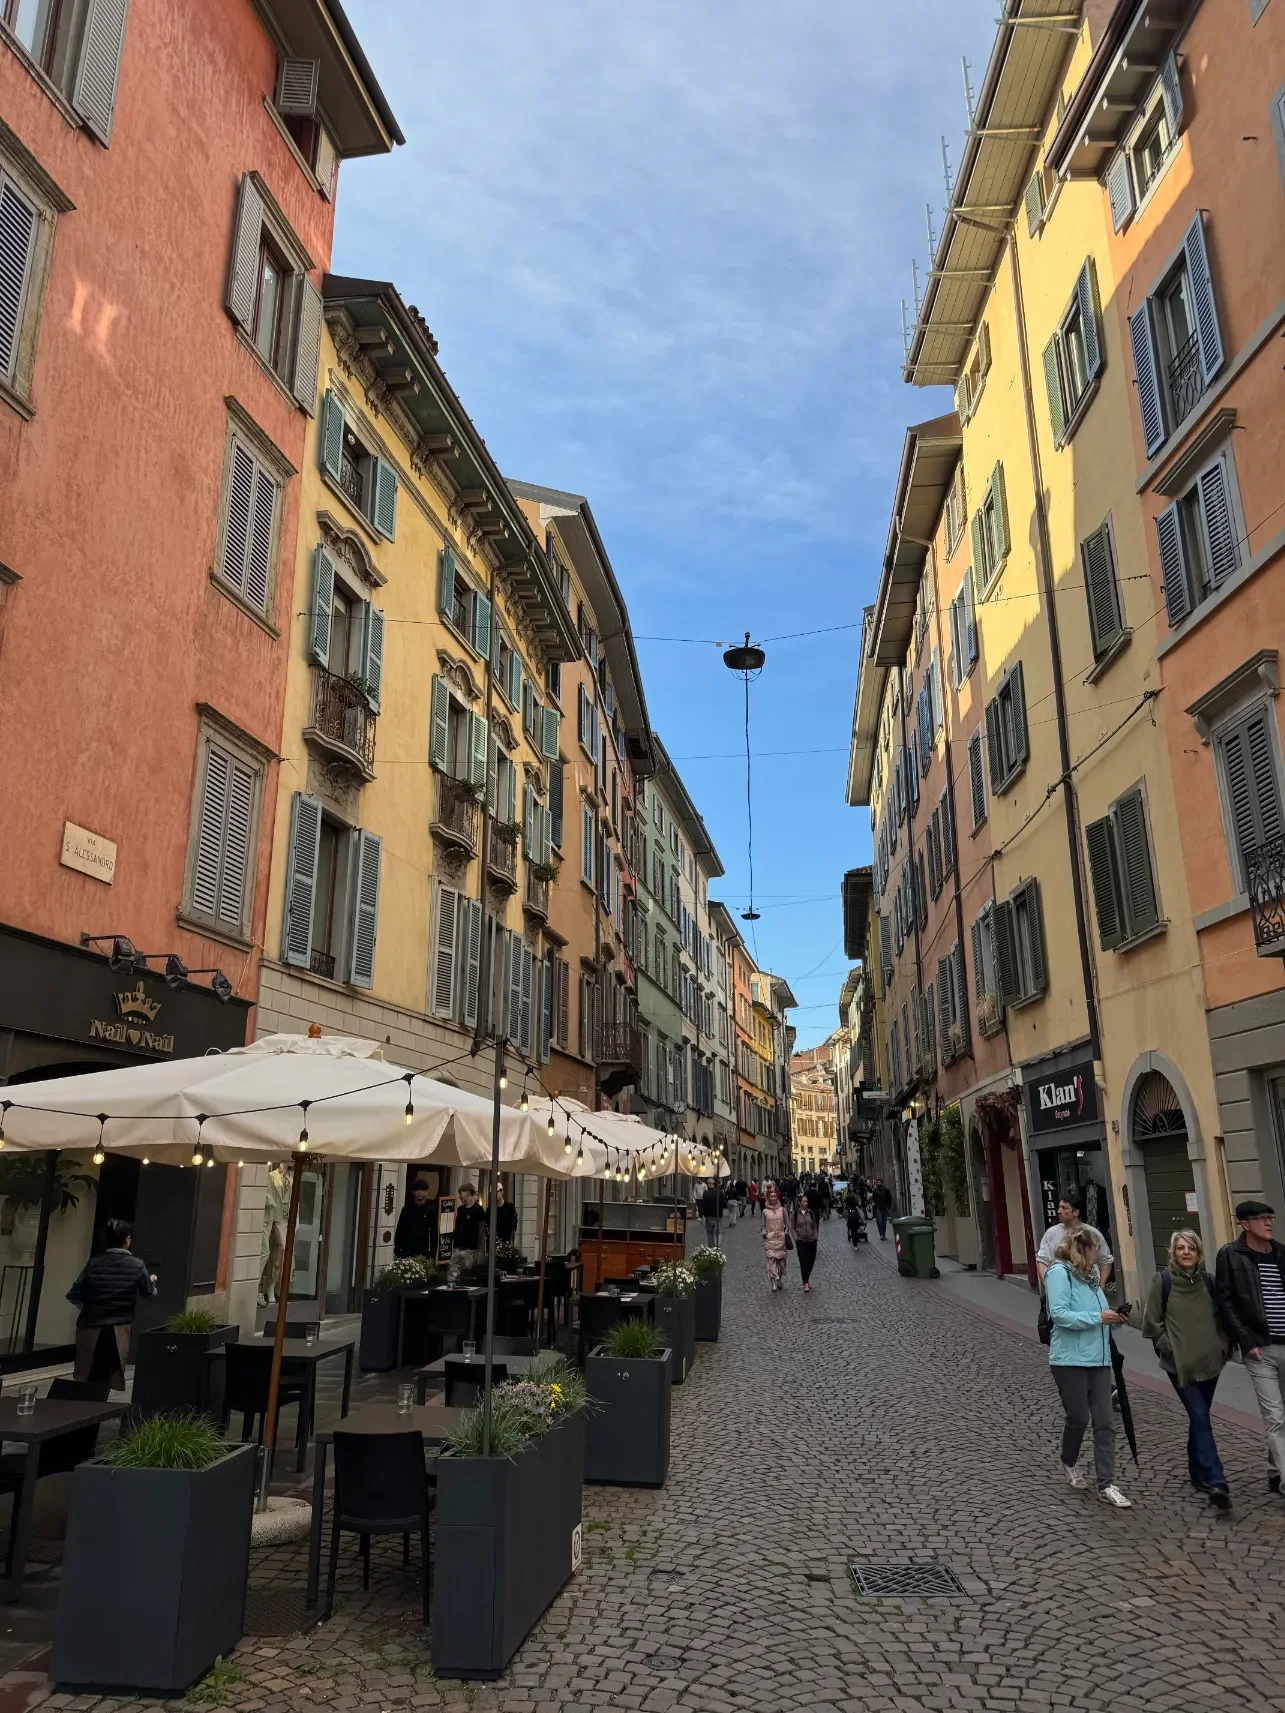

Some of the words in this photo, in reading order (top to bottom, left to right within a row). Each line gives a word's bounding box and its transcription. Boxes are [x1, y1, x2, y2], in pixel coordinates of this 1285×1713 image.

[87, 836, 96, 846] VIA
[74, 845, 113, 871] ALESSANDRO
[88, 1019, 127, 1043] Nail
[139, 1030, 175, 1053] Nail
